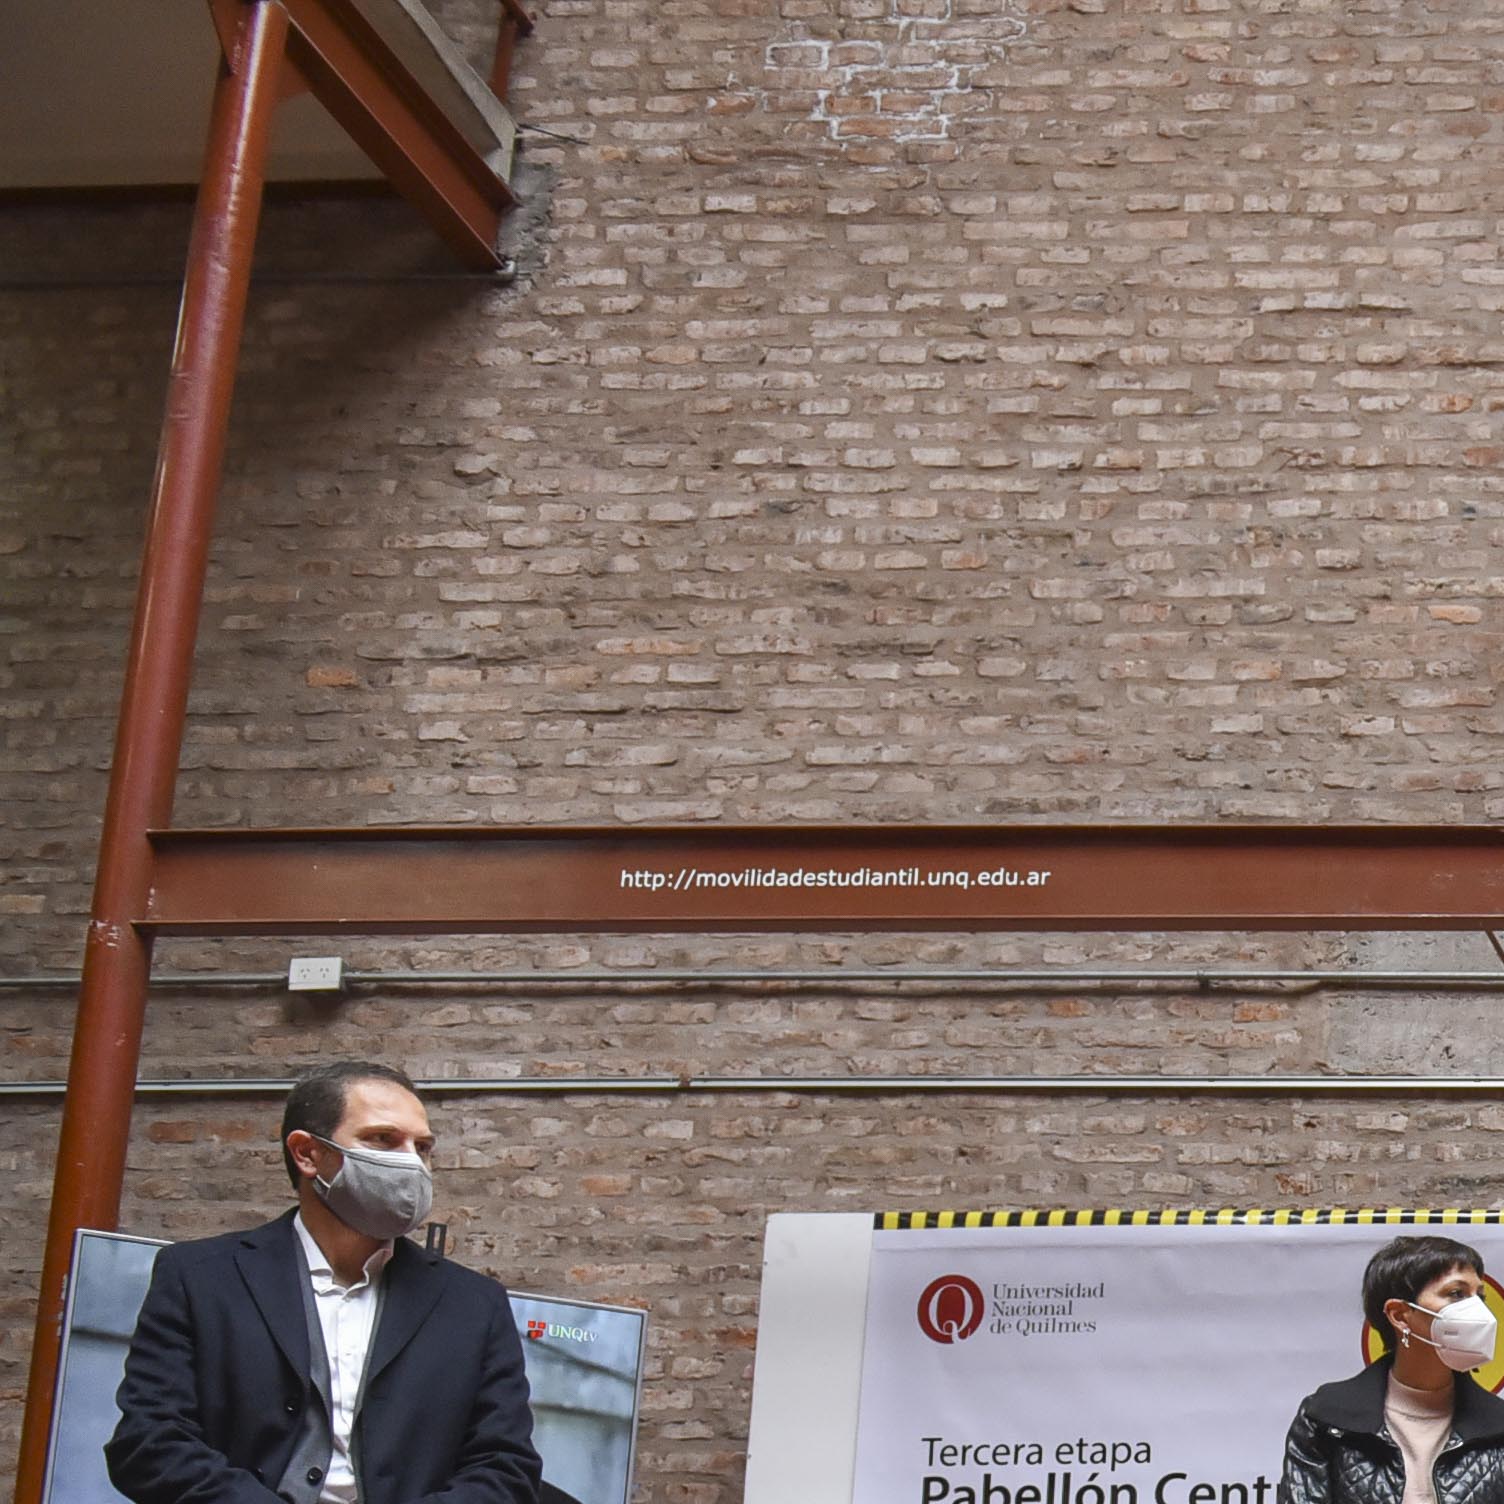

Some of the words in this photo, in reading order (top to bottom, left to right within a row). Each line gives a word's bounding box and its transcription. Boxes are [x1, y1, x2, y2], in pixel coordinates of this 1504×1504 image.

[620, 868, 1051, 890] http://movilidadestudiantil.unq.edu.ar
[994, 1283, 1104, 1299] Universidad
[992, 1300, 1072, 1316] Nacional
[549, 1324, 597, 1343] UNQtv
[990, 1319, 1011, 1334] de
[1016, 1318, 1096, 1336] Quilmes
[922, 1438, 1042, 1466] Tercera
[1056, 1438, 1150, 1471] etapa
